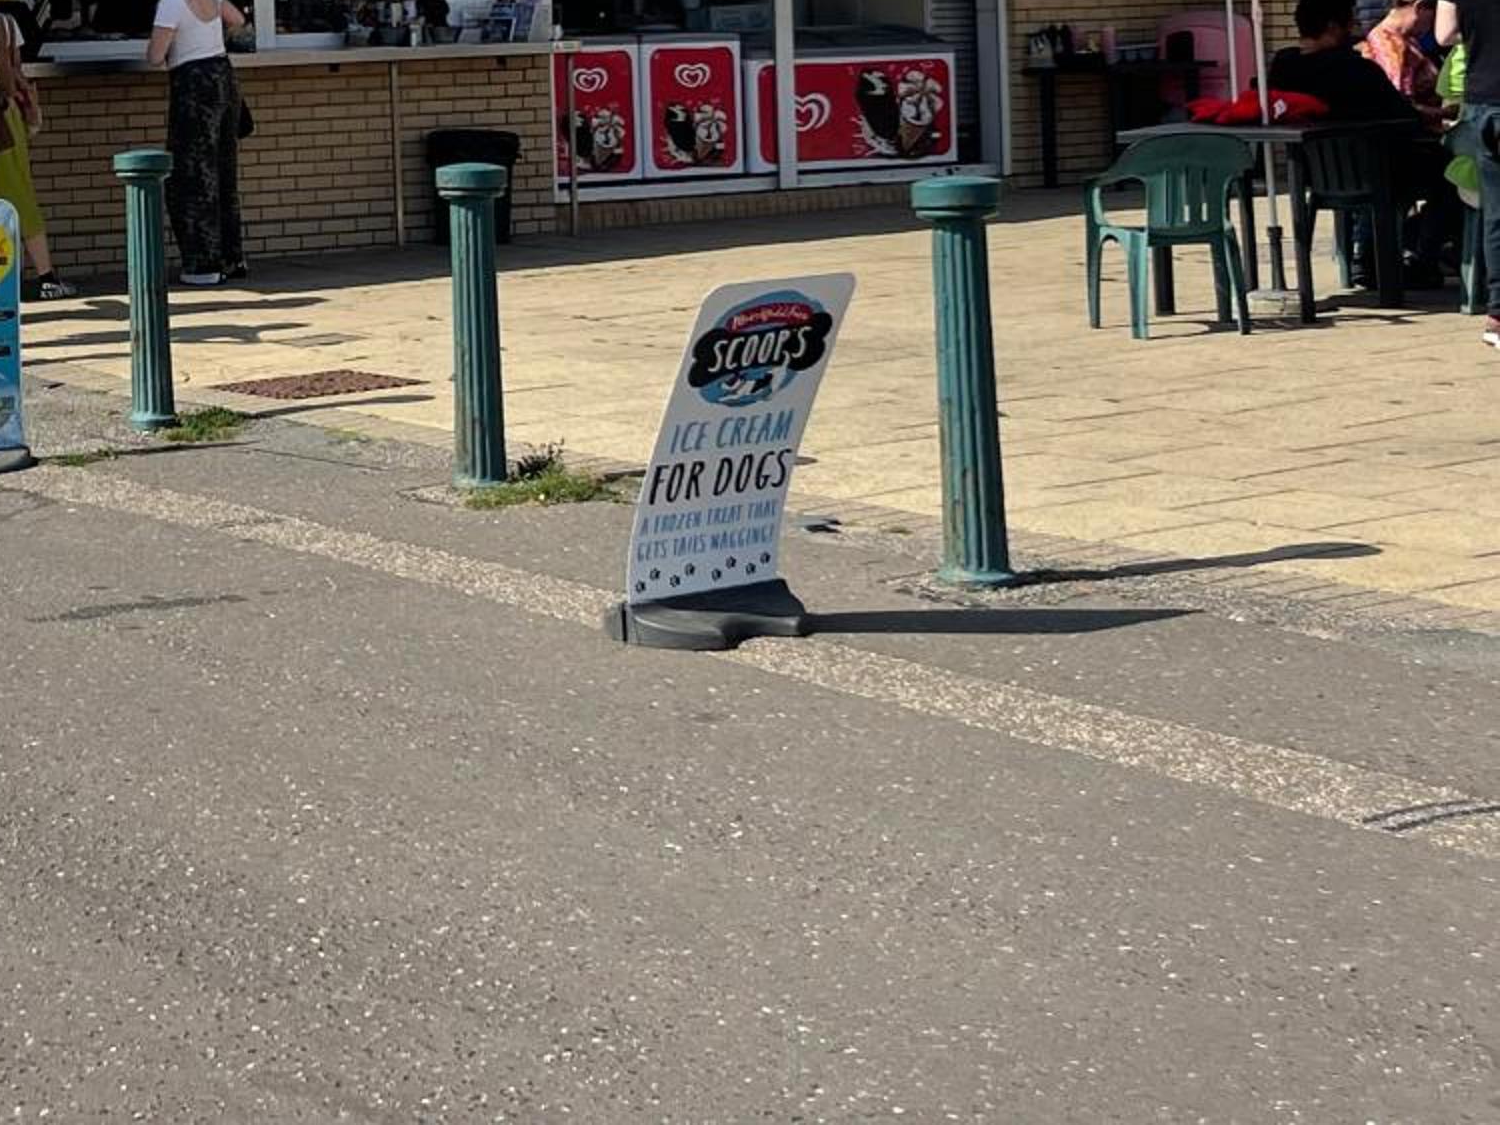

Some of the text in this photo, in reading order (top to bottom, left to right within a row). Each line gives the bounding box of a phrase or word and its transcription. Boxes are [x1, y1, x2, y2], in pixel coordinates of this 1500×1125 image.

[670, 407, 795, 455] ICE CREAM
[648, 448, 793, 506] FOR DOGS
[640, 498, 779, 535] A FROZEN TREAT THAT
[637, 539, 667, 562] GETS
[673, 534, 707, 557] TAILS
